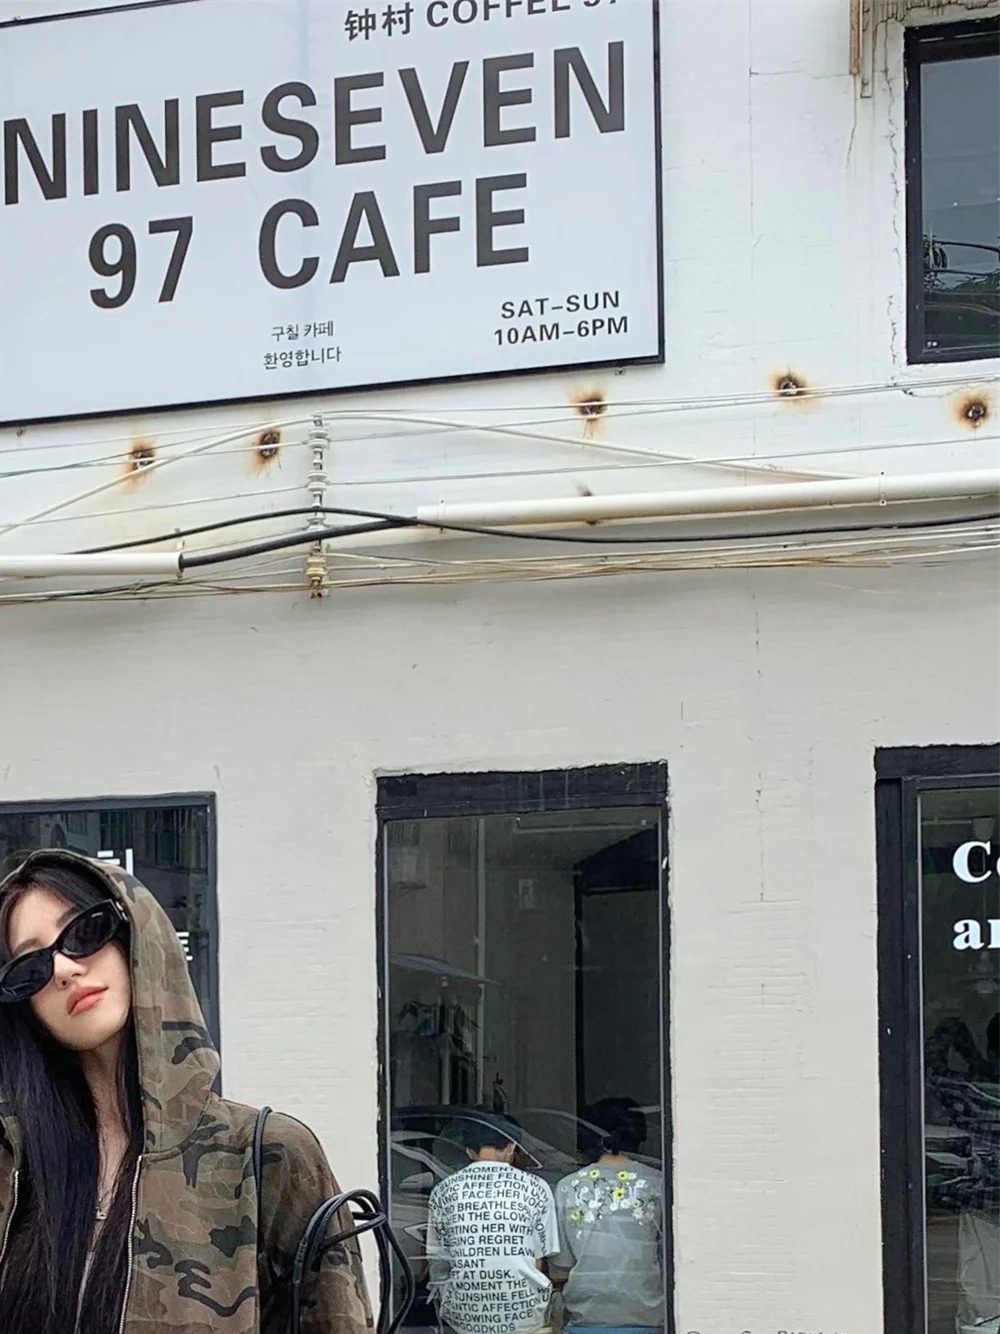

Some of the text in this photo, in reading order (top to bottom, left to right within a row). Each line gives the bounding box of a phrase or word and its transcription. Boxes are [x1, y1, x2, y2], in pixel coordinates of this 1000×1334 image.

[344, 3, 414, 42] 钟村
[3, 41, 627, 206] NINESEVEN
[87, 173, 530, 310] 97 CAFE
[271, 320, 334, 342] 구칠 카페
[263, 346, 342, 370] 환영합니다
[498, 1172, 527, 1184] FELL
[462, 1180, 529, 1194] AFFECTION
[468, 1211, 491, 1221] THE
[481, 1223, 506, 1233] HER
[509, 1223, 534, 1236] WITH
[478, 1234, 524, 1245] REGRET
[463, 1270, 476, 1280] AT
[479, 1269, 515, 1280] DUSK.
[506, 1278, 527, 1289] THE
[454, 1291, 508, 1302] SUNSHINE
[511, 1288, 535, 1299] FELL
[505, 1308, 533, 1322] FACE
